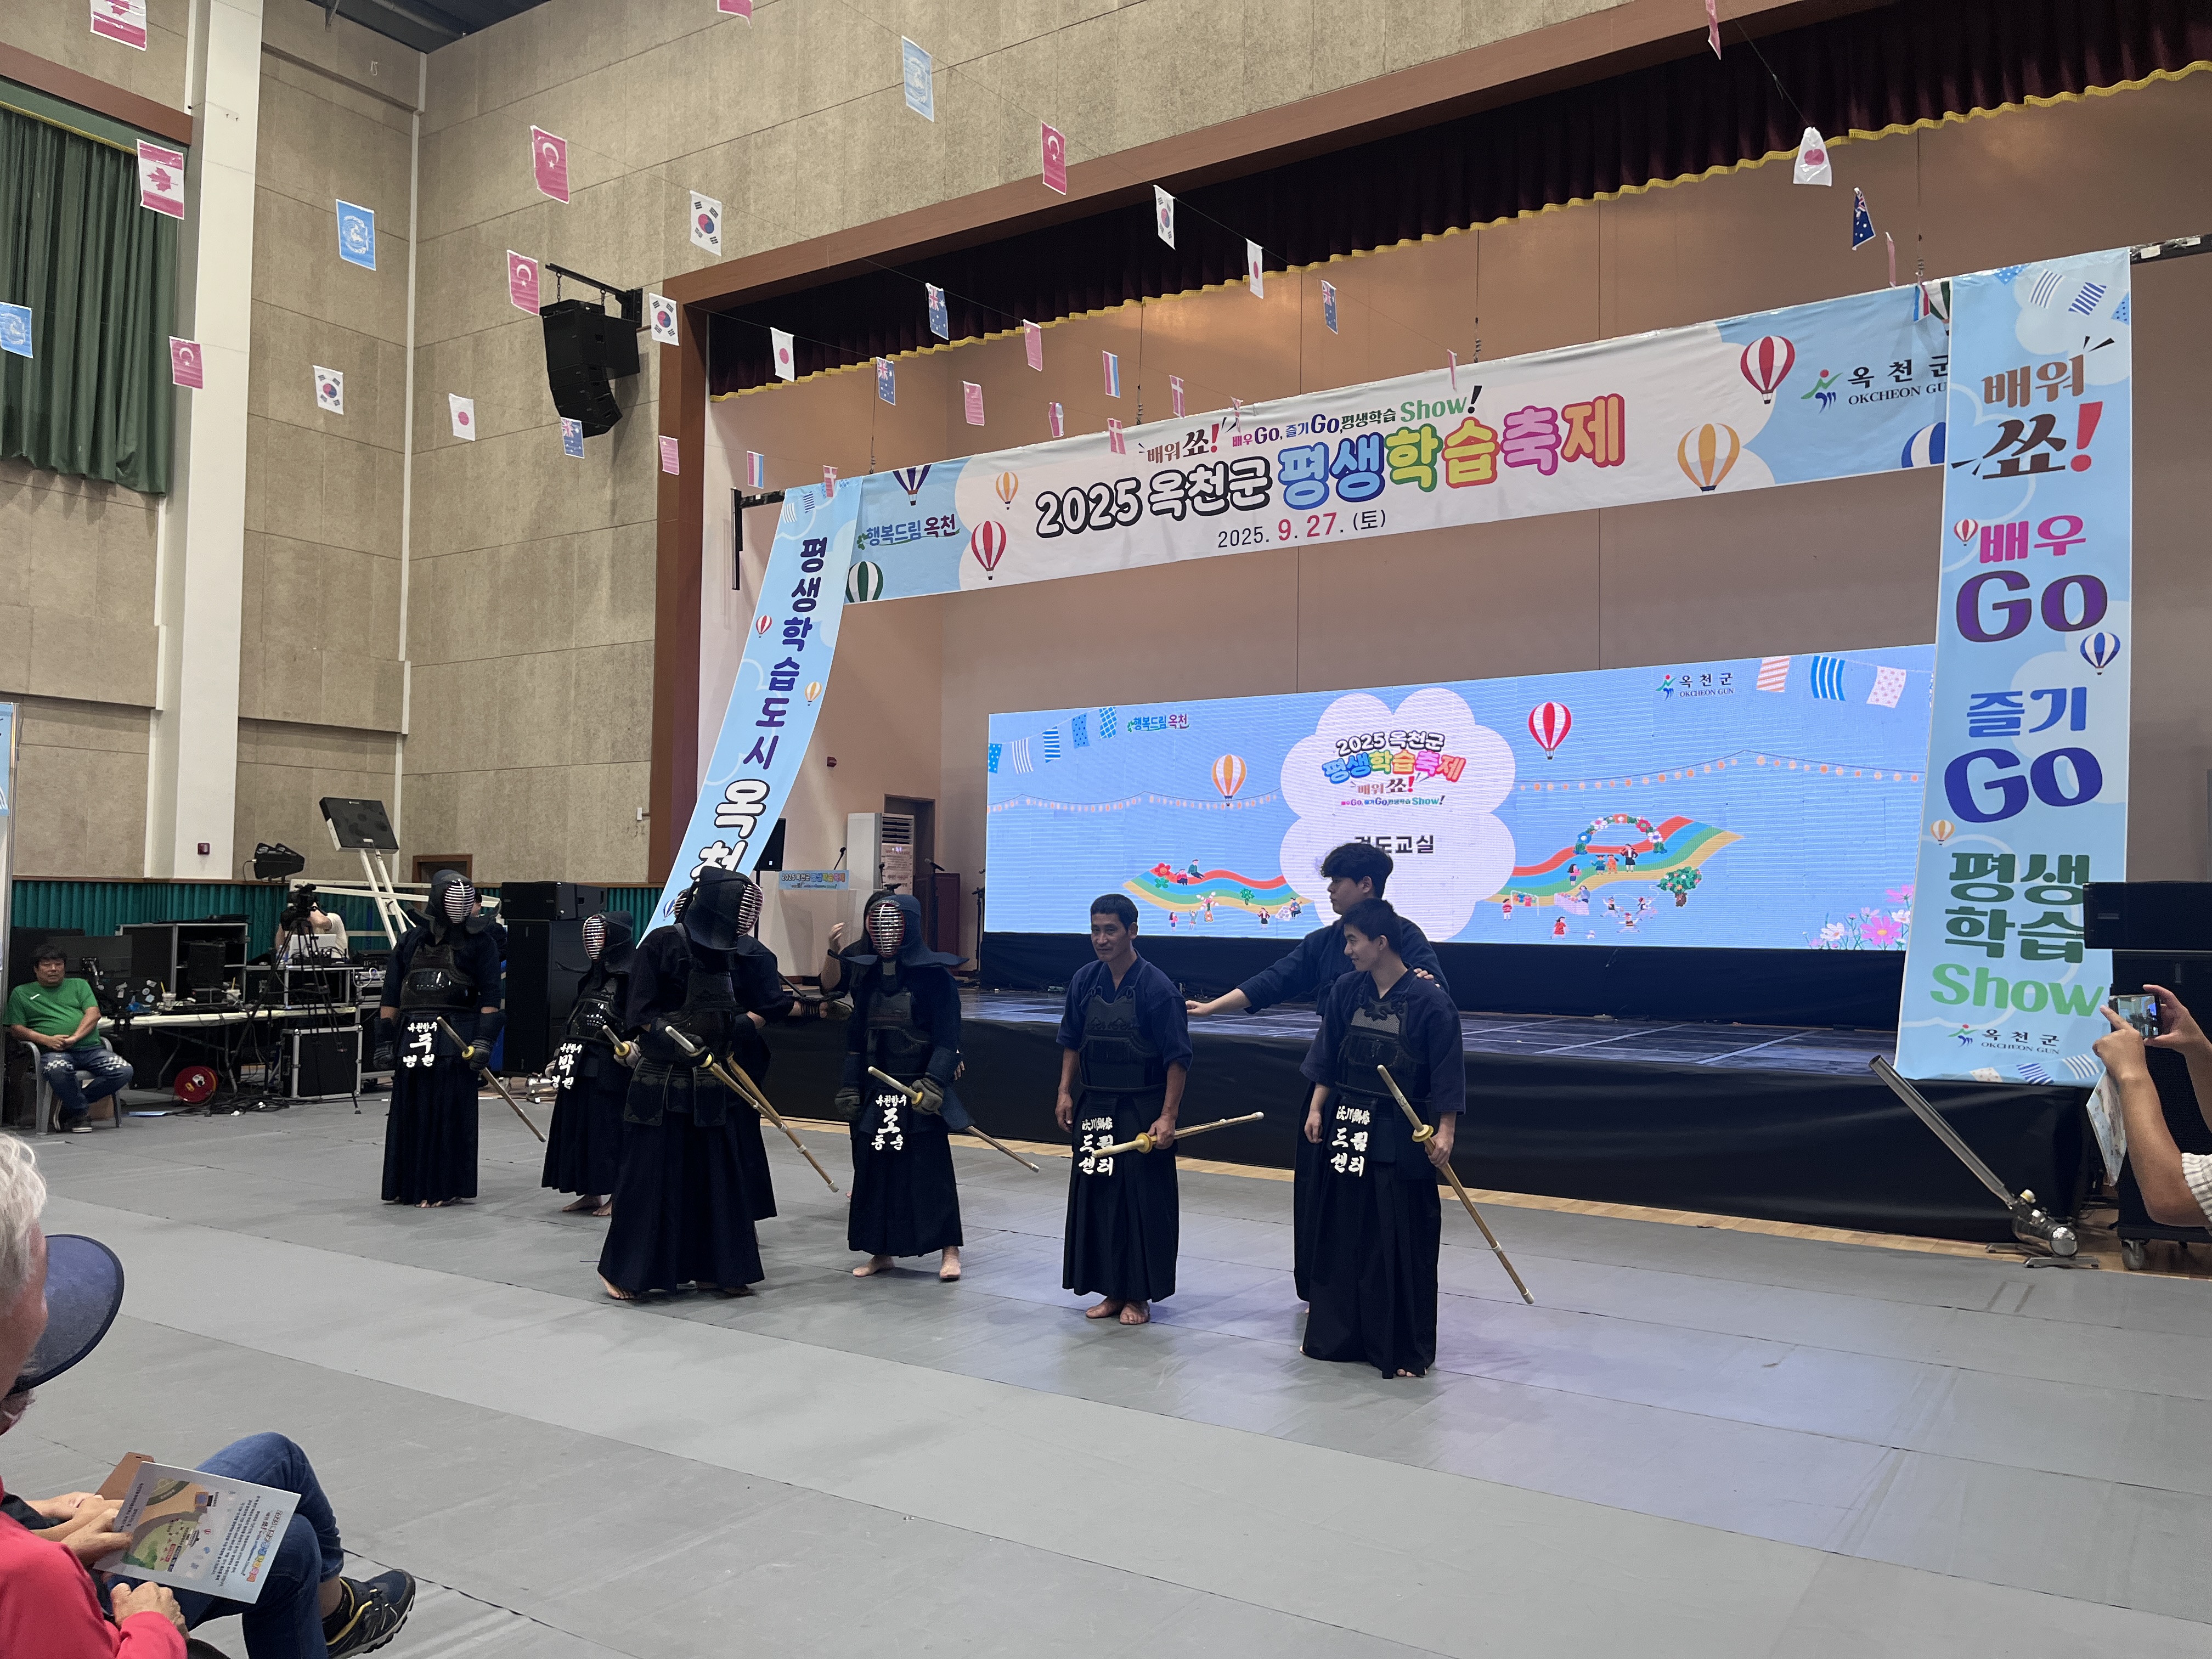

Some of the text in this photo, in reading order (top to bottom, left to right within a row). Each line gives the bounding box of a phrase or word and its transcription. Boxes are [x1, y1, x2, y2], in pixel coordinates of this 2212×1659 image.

[1848, 382, 1947, 405] OKCHEON GU
[1981, 354, 2085, 409] 배워
[1147, 441, 1180, 464] 배워
[1341, 408, 1396, 430] 평생학습
[1401, 385, 1482, 422] Show!
[1035, 393, 1625, 538] 2025 옥천군 평생학습축제
[866, 514, 956, 546] 행복드림 옥천
[1218, 509, 1386, 548] 2025. 9. 27. (토)
[1979, 515, 2086, 564] 배우
[1956, 570, 2108, 643] Go
[743, 536, 828, 770] 평생학습도시
[1679, 673, 1733, 688] 옥천군
[1680, 690, 1716, 698] OKCHEON
[1133, 713, 1187, 730] 행복드림 옥천
[1967, 686, 2087, 738] 즐기
[1336, 730, 1445, 757] 2025 옥천군
[1322, 749, 1466, 785] 평생학습축제
[1944, 747, 2103, 823] Go
[1357, 783, 1384, 794] 배워
[1412, 795, 1446, 805] Show!
[781, 873, 795, 882] 2025
[1949, 853, 2090, 905] 평생
[1945, 906, 2084, 963] 학습
[1930, 963, 2104, 1017] Show
[1981, 1042, 2033, 1052] OKCHEON
[1982, 1029, 2059, 1047] 옥천군
[877, 1107, 901, 1134] 조
